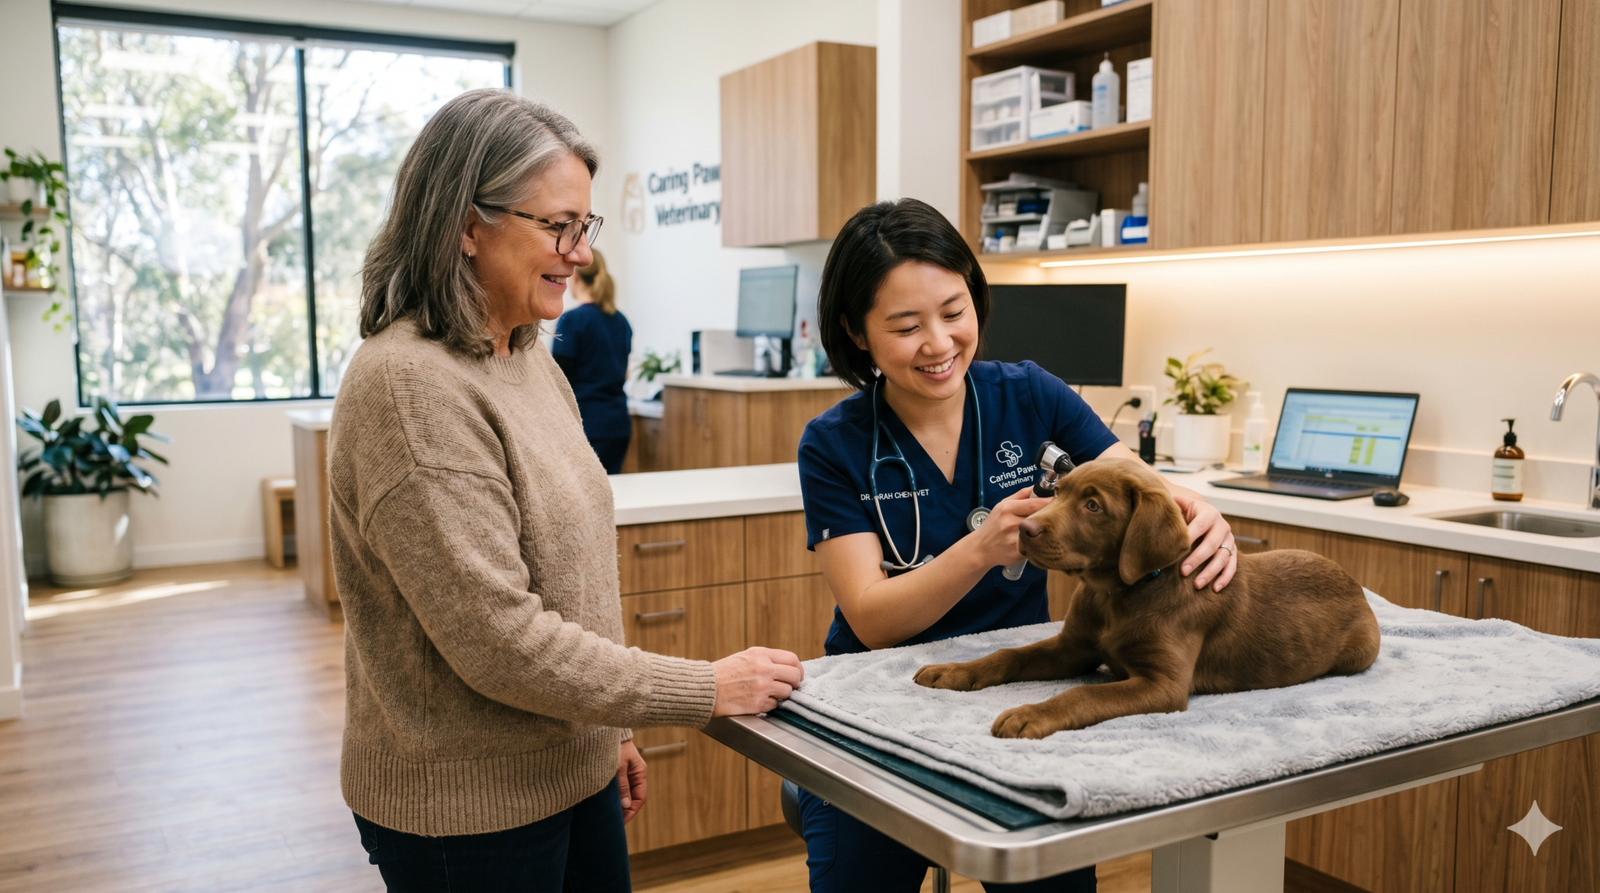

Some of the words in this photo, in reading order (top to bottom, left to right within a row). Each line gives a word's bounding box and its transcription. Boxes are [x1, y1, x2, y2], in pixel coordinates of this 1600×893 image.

[648, 167, 688, 194] Caring
[655, 198, 721, 226] Veterinary
[989, 471, 1017, 484] Caring
[1016, 463, 1038, 476] Paws
[998, 475, 1034, 489] Veterinary
[860, 493, 874, 501] DR.
[894, 490, 913, 499] CHEN
